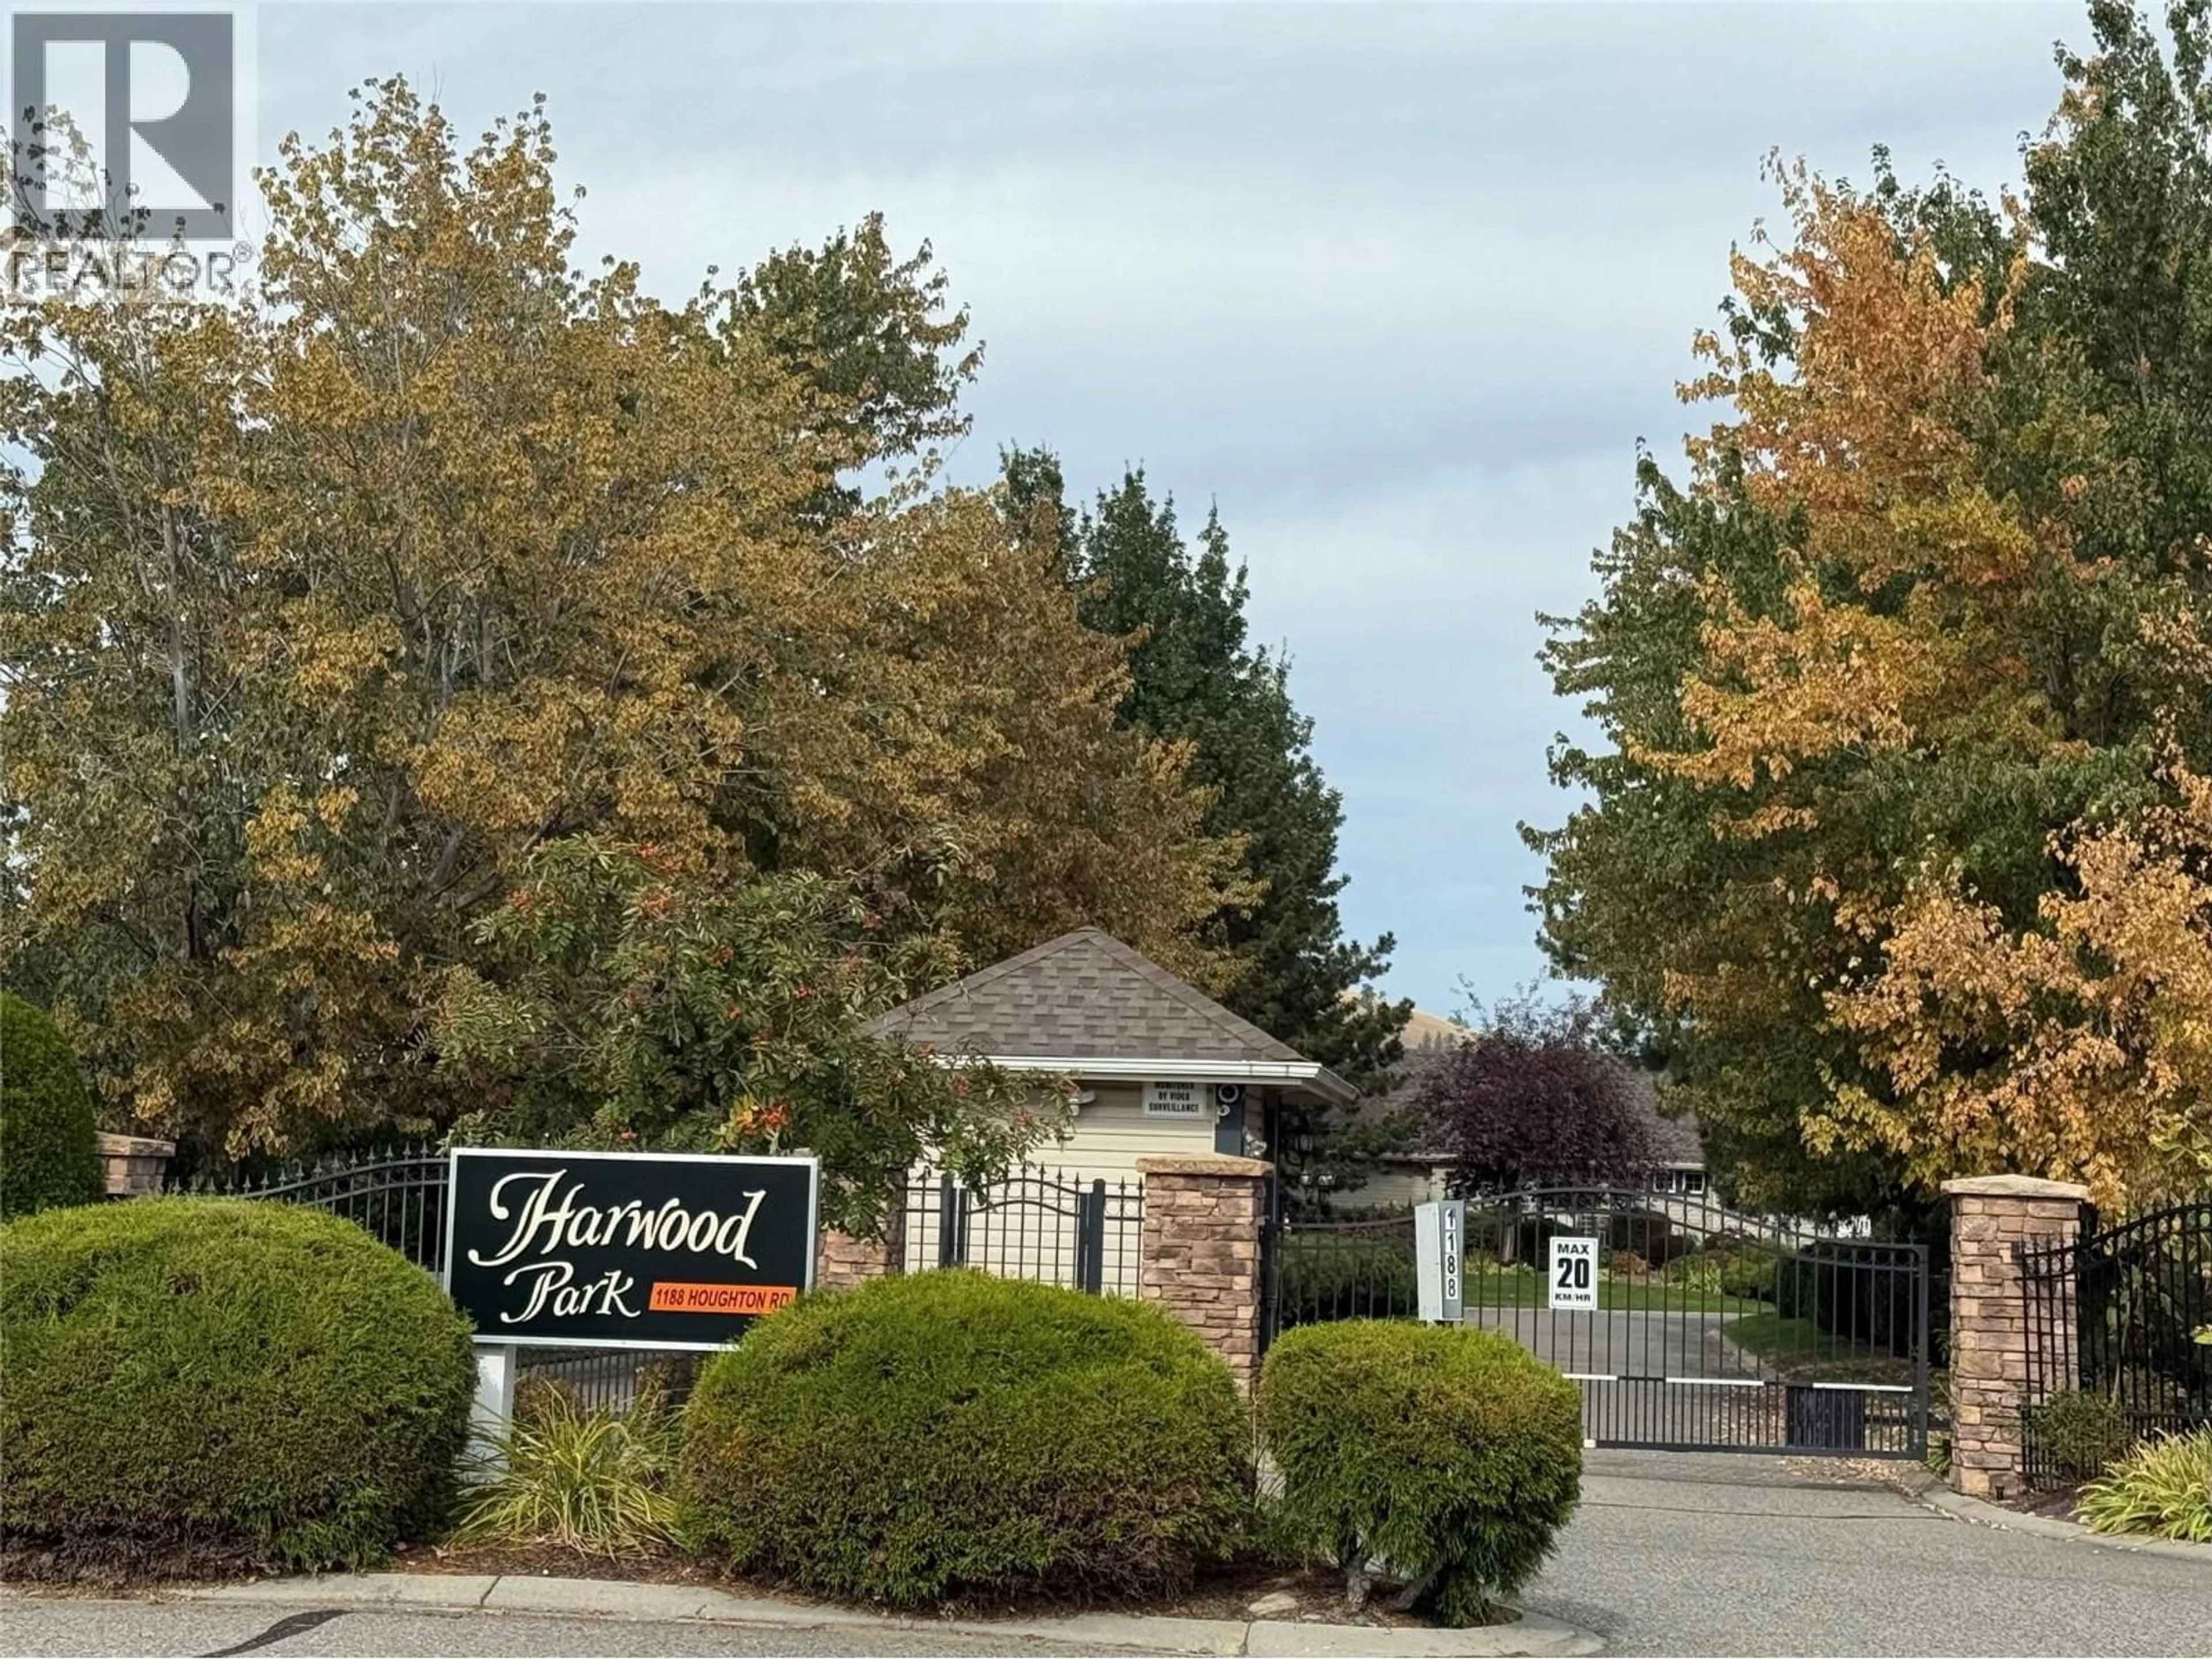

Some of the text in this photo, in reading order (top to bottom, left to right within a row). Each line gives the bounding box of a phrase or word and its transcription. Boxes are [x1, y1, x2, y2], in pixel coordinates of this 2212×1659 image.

[467, 1168, 766, 1270] Harwood
[1446, 1209, 1457, 1298] 1188
[1557, 1243, 1590, 1255] MAX
[499, 1261, 641, 1324] Park
[1557, 1257, 1590, 1289] 20
[656, 1289, 789, 1309] 1188 HOUGHTON RD
